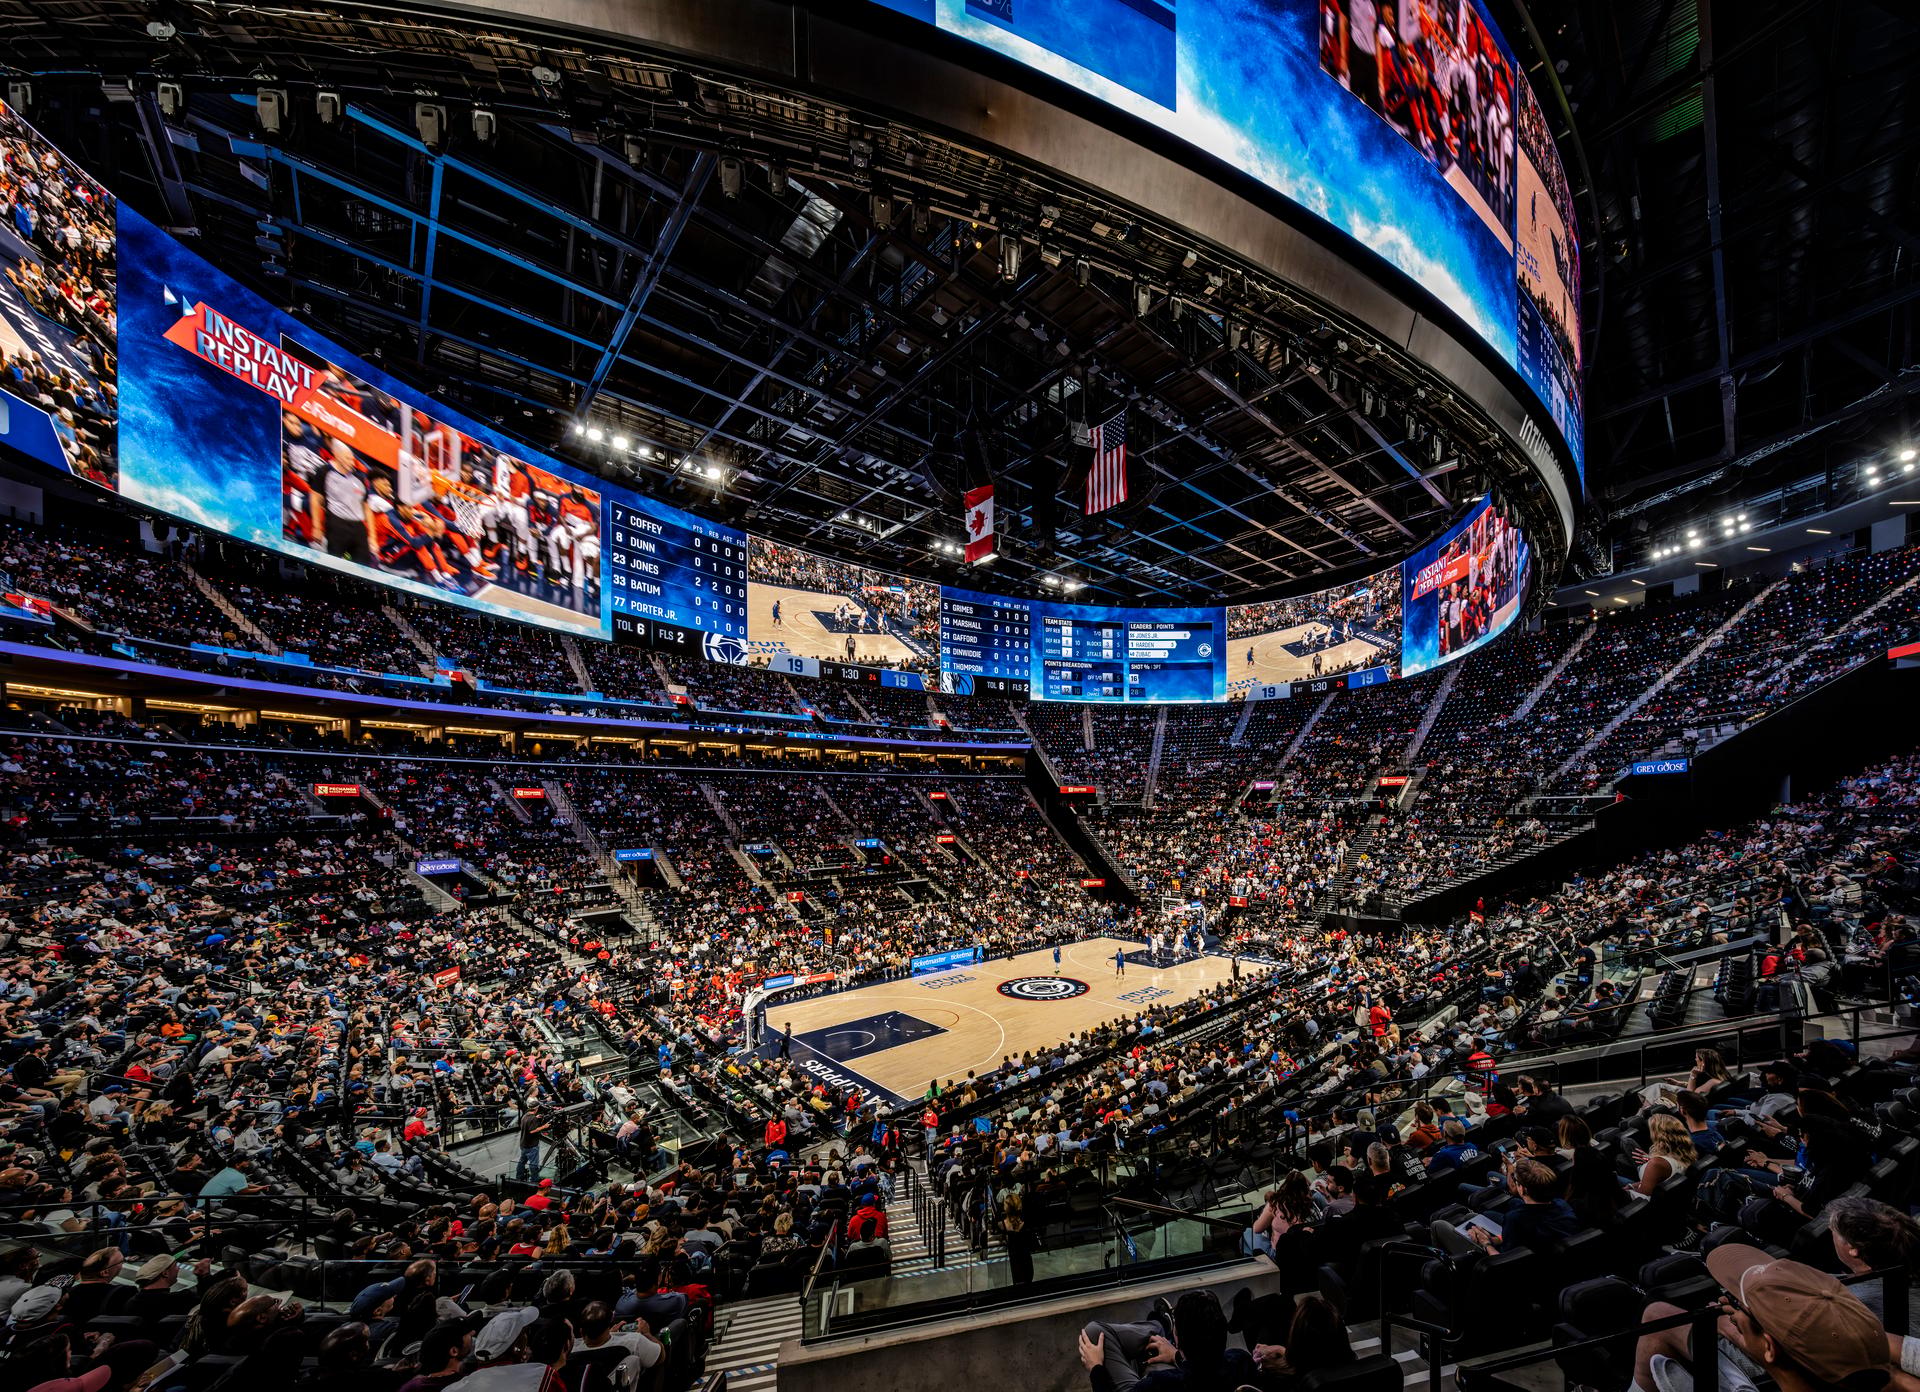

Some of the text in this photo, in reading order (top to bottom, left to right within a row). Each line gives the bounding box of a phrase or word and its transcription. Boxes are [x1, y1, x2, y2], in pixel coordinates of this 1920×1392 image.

[204, 307, 314, 389] INSTANT
[196, 328, 298, 404] REPLAY
[616, 511, 744, 561] 7 COFFEY 0 0 0 0
[693, 524, 746, 547] PTS REB AST FLS
[616, 532, 744, 579] 8 DUNN 0 1 0 0
[613, 553, 744, 598] 23 JONES 2 2 0 0
[1418, 557, 1448, 582] INSTANT
[1418, 575, 1443, 594] REPLAY
[613, 574, 744, 616] 33 BATUM 0 0 0 0
[613, 596, 744, 635] 77 PORTER JR. 0 1 0 0
[953, 604, 973, 614] GRIMES
[616, 619, 645, 635] TOL 6
[953, 619, 982, 629] MARSHALL
[659, 629, 684, 643] FLS 2
[953, 634, 977, 643] GAFFORD
[953, 648, 981, 658] DINWIDDIE
[788, 658, 803, 672] 19
[953, 663, 983, 672] THOMPSON
[842, 668, 859, 679] 1:30
[894, 674, 908, 687] 19
[1360, 672, 1373, 685] 19
[999, 682, 1004, 690] 6
[1262, 686, 1276, 698] 19
[1311, 681, 1327, 692] 1:30
[1657, 762, 1685, 771] GOOSE
[913, 956, 946, 968] ticketmaster
[1116, 986, 1159, 1000] INTUIT
[800, 1060, 872, 1100] CLIPPERS
